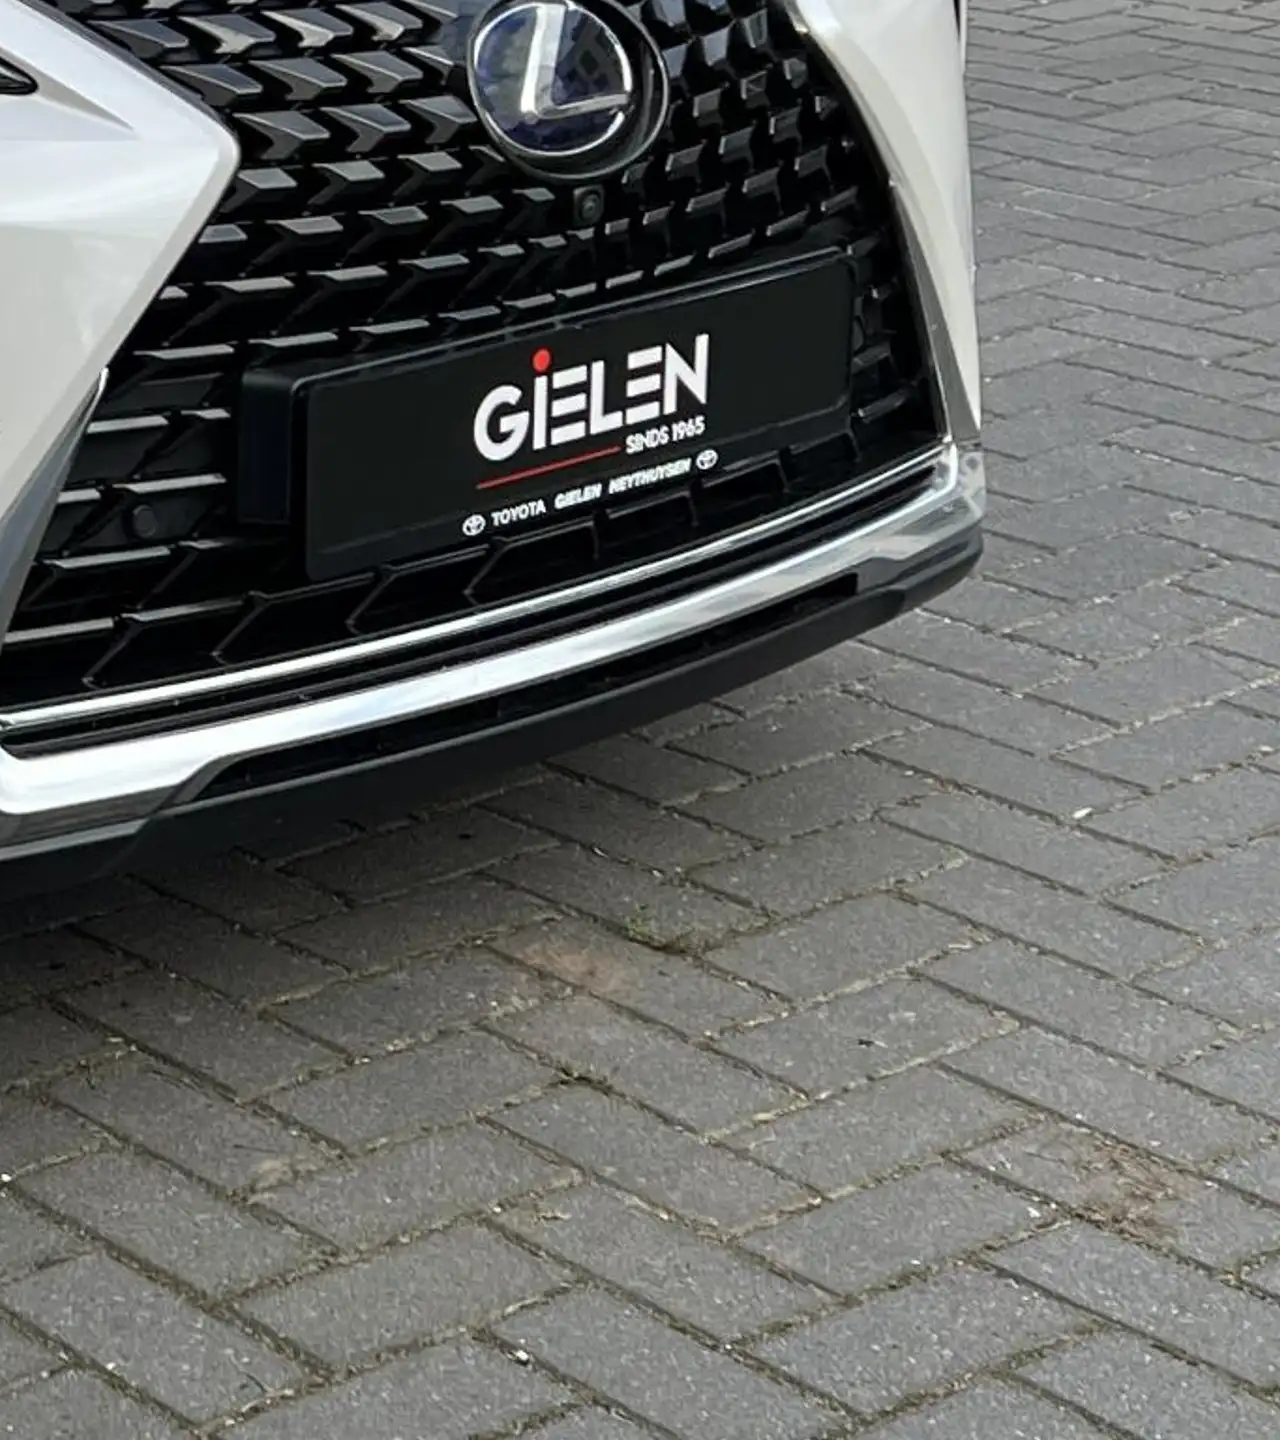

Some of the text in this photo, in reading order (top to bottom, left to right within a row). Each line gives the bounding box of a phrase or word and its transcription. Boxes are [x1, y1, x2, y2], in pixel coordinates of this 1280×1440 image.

[626, 416, 706, 454] SINDS 1965
[491, 500, 546, 527] TOYOTA
[554, 483, 602, 510] GIELEN
